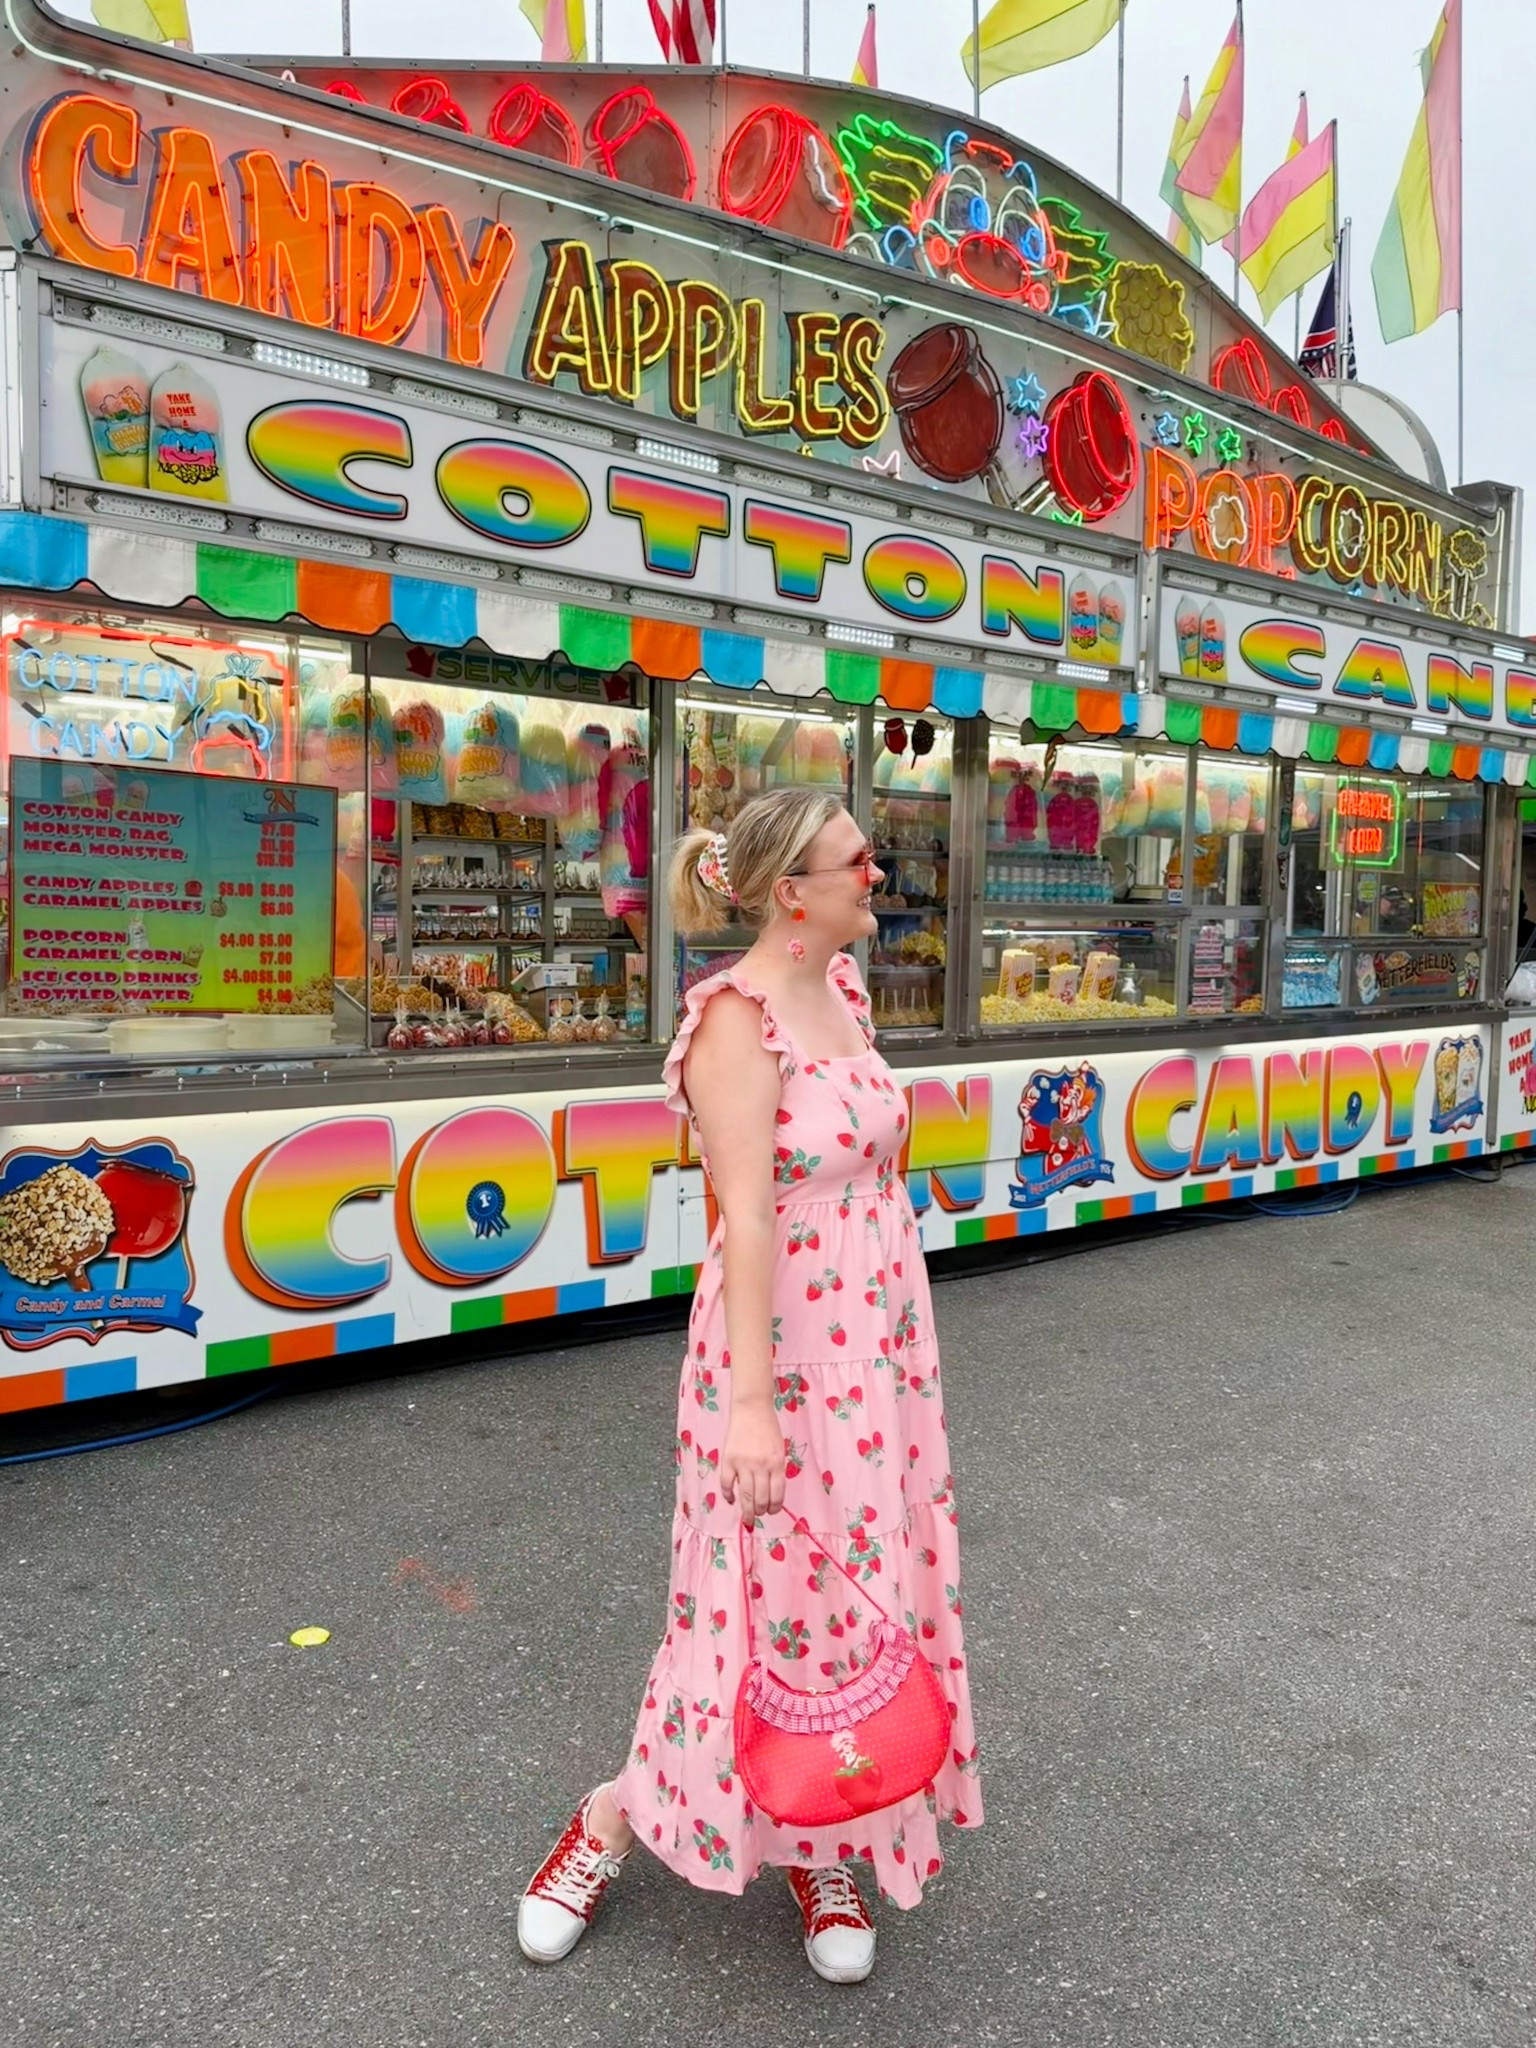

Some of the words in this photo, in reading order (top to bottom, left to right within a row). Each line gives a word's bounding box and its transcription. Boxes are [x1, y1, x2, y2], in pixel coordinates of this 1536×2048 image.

[25, 91, 518, 366] CANDY
[525, 238, 891, 449] APPLES
[167, 393, 192, 405] TAKE
[168, 405, 197, 417] HOME
[246, 399, 1066, 646] COTTON
[17, 648, 198, 706] COTTON
[436, 650, 602, 696] SERVICE
[29, 715, 185, 763] CANDY
[23, 802, 111, 821] COTTON
[115, 809, 184, 826] CANDY
[23, 820, 126, 840] MONSTER
[1349, 826, 1383, 854] CORN
[23, 839, 85, 856] MEGA
[89, 843, 187, 863] MONSTER
[23, 874, 96, 891] CANDY
[98, 877, 178, 895] APPLES
[23, 893, 125, 911] CARAMEL
[128, 896, 206, 914] APPLES
[23, 928, 129, 945] POPCORN
[23, 946, 124, 963] CARAMEL
[126, 949, 184, 964] CORN
[22, 969, 62, 984] ICE
[64, 970, 120, 985] COLD
[123, 971, 201, 986] DRINKS
[22, 988, 121, 1003] BOTTLED
[121, 988, 194, 1003] WATER
[1508, 1028, 1532, 1052] TAKE
[224, 1074, 993, 1312] COTN
[1126, 1038, 1430, 1181] CANDY
[16, 1297, 68, 1315] Candy
[73, 1296, 105, 1312] and
